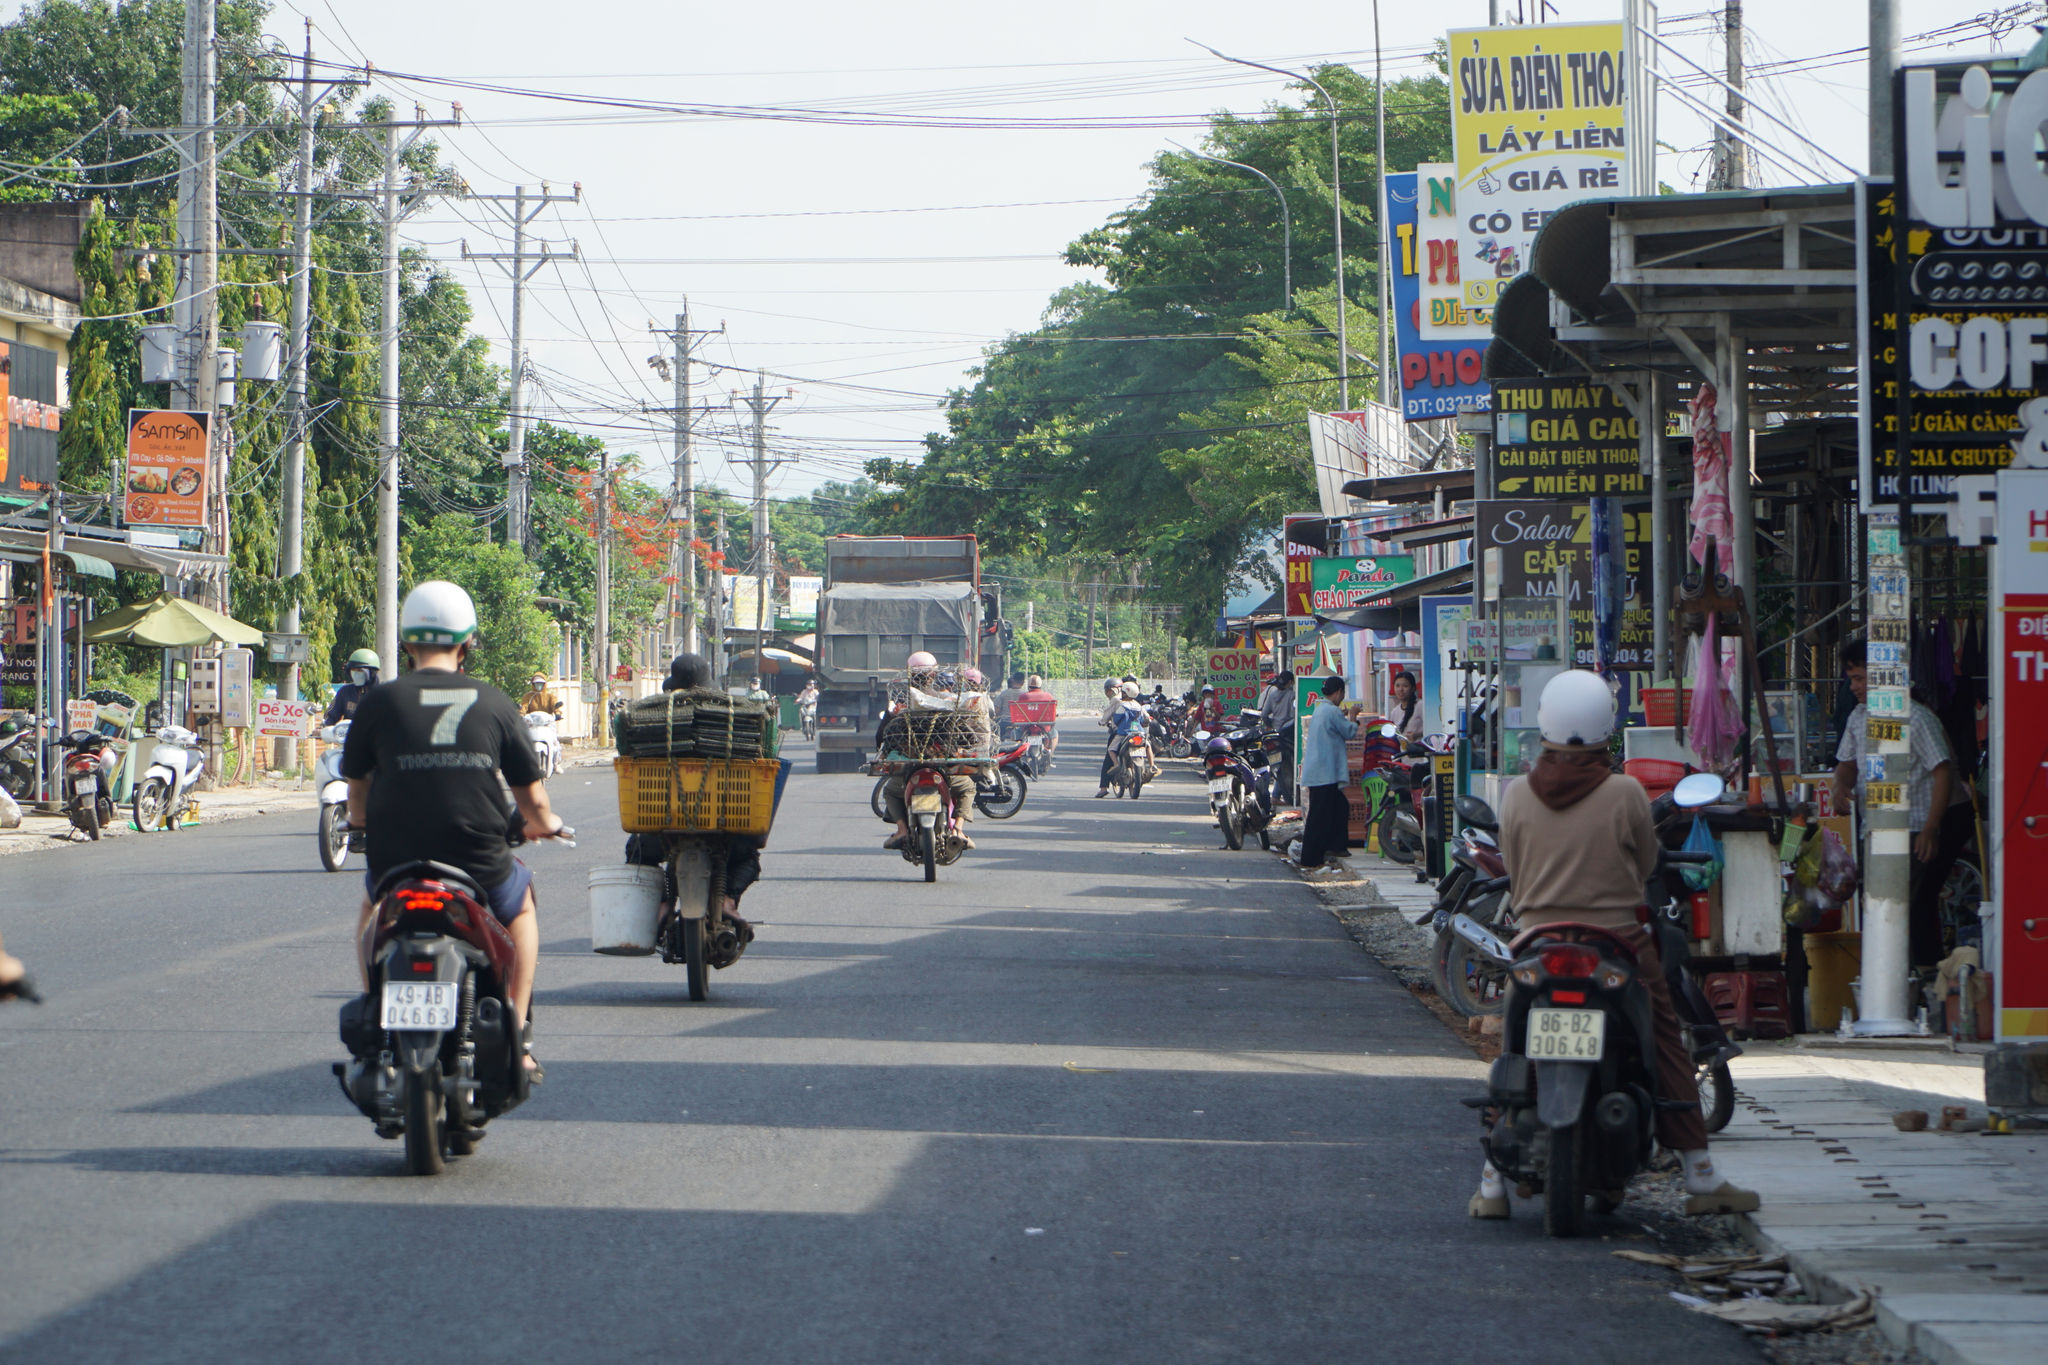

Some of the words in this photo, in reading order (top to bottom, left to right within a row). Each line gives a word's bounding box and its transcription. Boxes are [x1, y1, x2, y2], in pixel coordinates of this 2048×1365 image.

[1460, 38, 1507, 113] SỬA
[1510, 45, 1564, 121] ĐIỆN
[1478, 125, 1544, 154] LẤY
[1554, 121, 1625, 150] LIỀN
[1508, 166, 1568, 191] GIÁ
[1578, 161, 1619, 189] RẺ
[1468, 209, 1513, 235] CÓ
[1407, 399, 1432, 415] ĐT:
[1497, 388, 1543, 410] THU
[1551, 383, 1604, 410] MÁY
[1530, 414, 1580, 442] GIÁ
[1884, 413, 1920, 432] TƯ
[1924, 410, 1967, 432] GIÃN
[1971, 409, 2018, 432] CĂNG
[1499, 447, 1524, 466] CÀI
[1528, 447, 1558, 469] ĐẶT
[1561, 446, 1597, 468] ĐIỆN
[1601, 447, 1640, 467] THOẠ
[1885, 449, 1947, 467] FCIAL
[1533, 469, 1597, 494] MIỄN
[1491, 509, 1575, 544] Salon
[1523, 540, 1577, 574] CẮT
[1337, 567, 1396, 583] Panda
[1210, 651, 1258, 671] CƠM
[1214, 682, 1257, 700] PHỞ
[284, 704, 304, 717] Xe
[419, 688, 478, 745] 7
[397, 752, 493, 769] THOUSAND
[396, 985, 444, 1005] 49-AB
[388, 1006, 449, 1025] 046.63
[1540, 1013, 1592, 1034] 86-B2
[1532, 1035, 1597, 1056] 306.48
